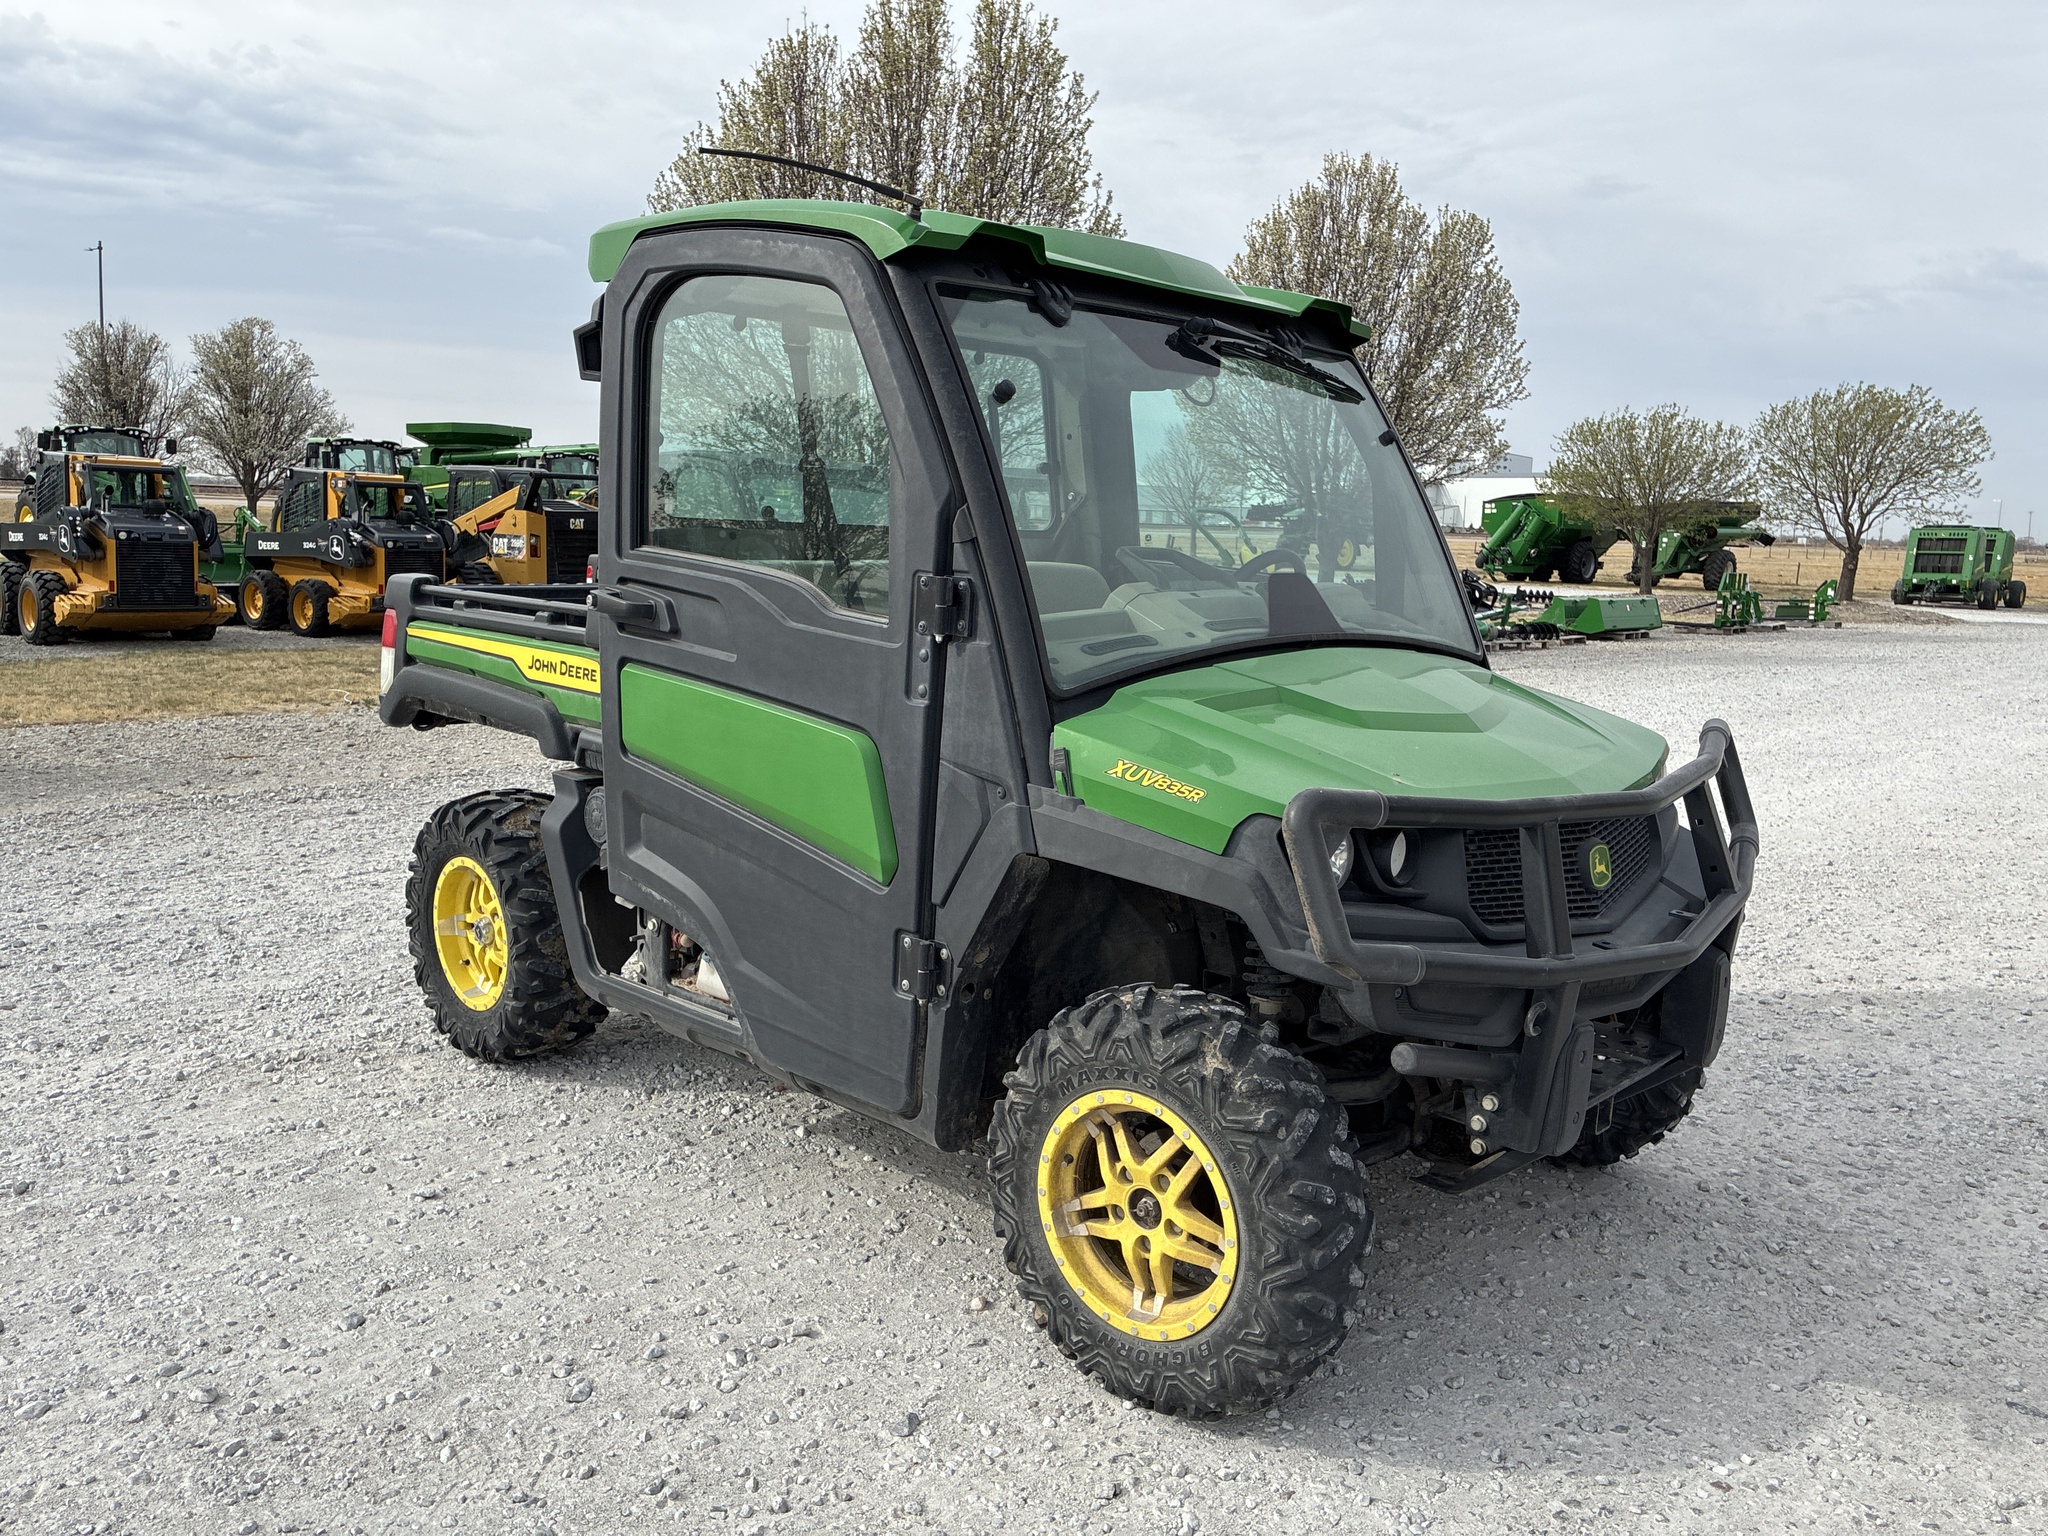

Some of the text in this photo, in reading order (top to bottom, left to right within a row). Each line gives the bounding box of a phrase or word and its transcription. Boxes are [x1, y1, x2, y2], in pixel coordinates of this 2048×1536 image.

[569, 518, 585, 530] CAT
[8, 530, 24, 542] DEERE
[257, 540, 280, 550] DEERE
[492, 537, 509, 554] CAT
[528, 655, 598, 682] JOHN DEERE
[1104, 758, 1207, 803] XUV835R
[1057, 1065, 1159, 1097] MAXXIS
[1057, 1293, 1213, 1368] BIGHORN 2.0
